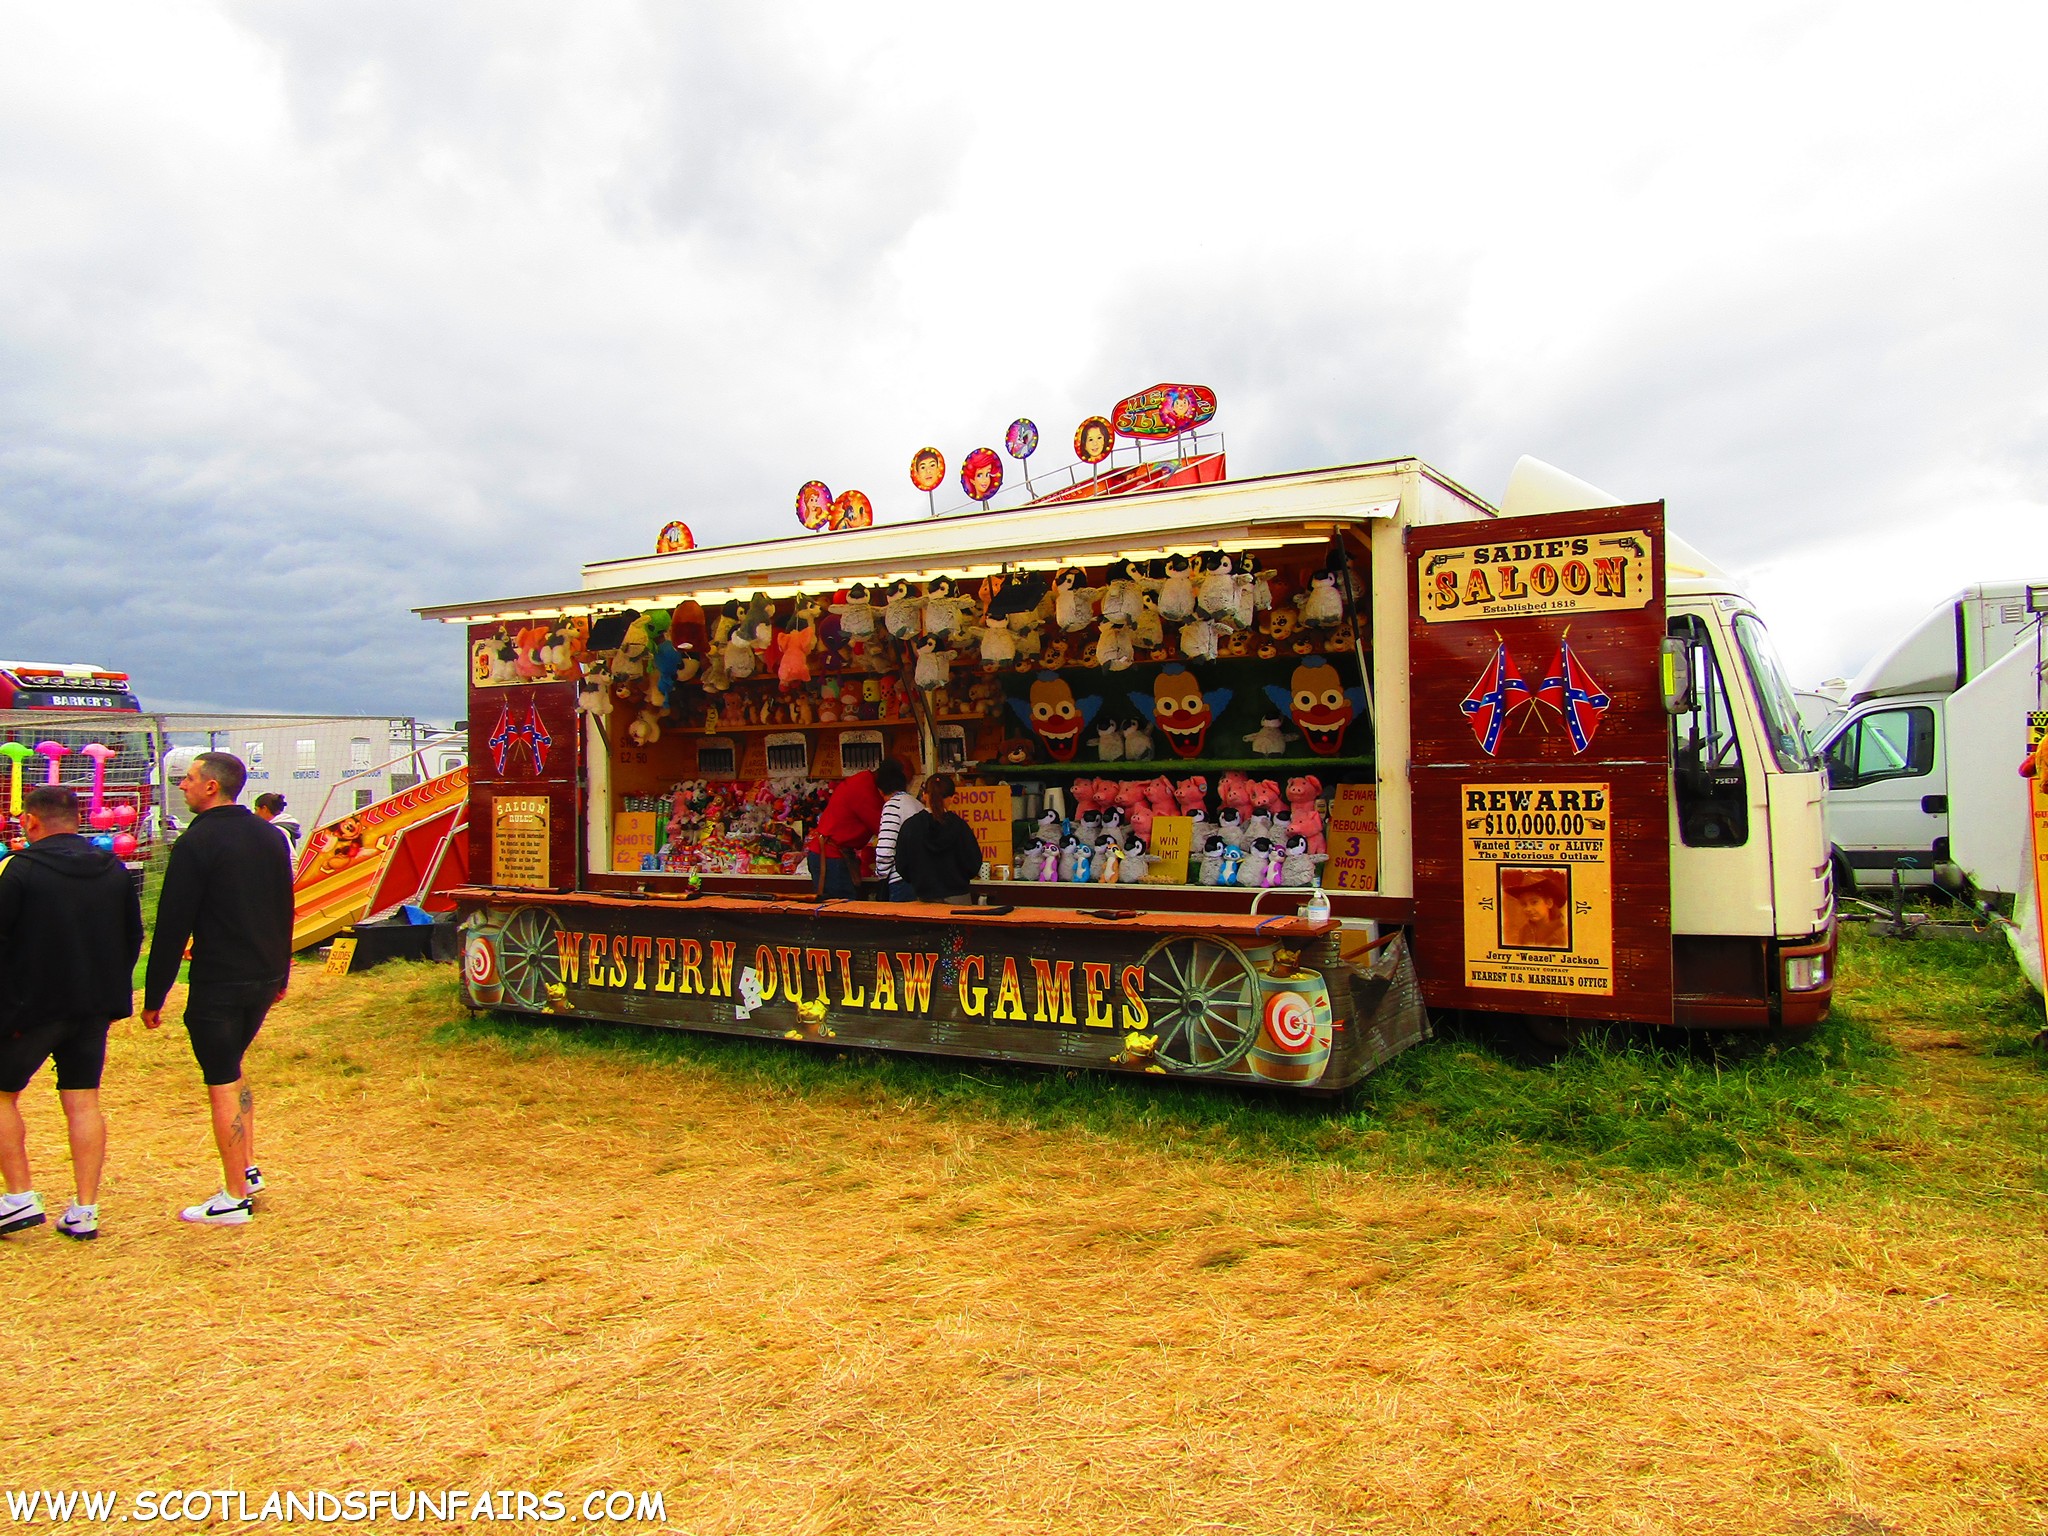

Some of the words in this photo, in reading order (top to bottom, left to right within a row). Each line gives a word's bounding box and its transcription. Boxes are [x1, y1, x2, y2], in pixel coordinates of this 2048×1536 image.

[1473, 539, 1589, 564] SADIE'S
[1434, 556, 1628, 610] SALOON
[1482, 601, 1547, 614] Established
[1551, 599, 1576, 609] 1818
[52, 695, 113, 707] BARKER'S
[293, 770, 319, 779] NEWCASTLE
[952, 791, 995, 804] SHOOT
[1466, 790, 1605, 811] REWARD
[496, 801, 546, 815] SALOON
[1352, 805, 1365, 816] OF
[509, 814, 533, 823] RULES
[973, 808, 1006, 822] BALL
[631, 818, 638, 829] 3
[1168, 823, 1173, 832] 1
[1332, 819, 1378, 832] REBOUNDS
[1485, 813, 1584, 836] $10,000.00
[615, 834, 654, 846] SHOTS
[1159, 836, 1179, 846] WIN
[1345, 836, 1360, 856] 3
[1473, 840, 1510, 850] Wanted
[1549, 842, 1560, 851] or
[1565, 841, 1603, 851] ALIVE!
[1157, 850, 1180, 860] LIMIT
[1478, 851, 1498, 859] The
[1503, 852, 1554, 860] Notorious
[1560, 852, 1598, 861] Outlaw
[1334, 857, 1366, 870] SHOTS
[340, 942, 347, 950] 4
[331, 951, 352, 961] SLIDES
[1486, 951, 1512, 963] Jerry
[1560, 955, 1600, 965] Jackson
[554, 930, 736, 998] WESTERN
[755, 945, 939, 1014] OUTLAW
[958, 954, 1149, 1031] GAMES
[1471, 971, 1507, 983] NEAREST
[1510, 973, 1525, 983] U.S.
[1528, 974, 1575, 986] MARSHAL'S
[1578, 976, 1608, 988] OFFICE
